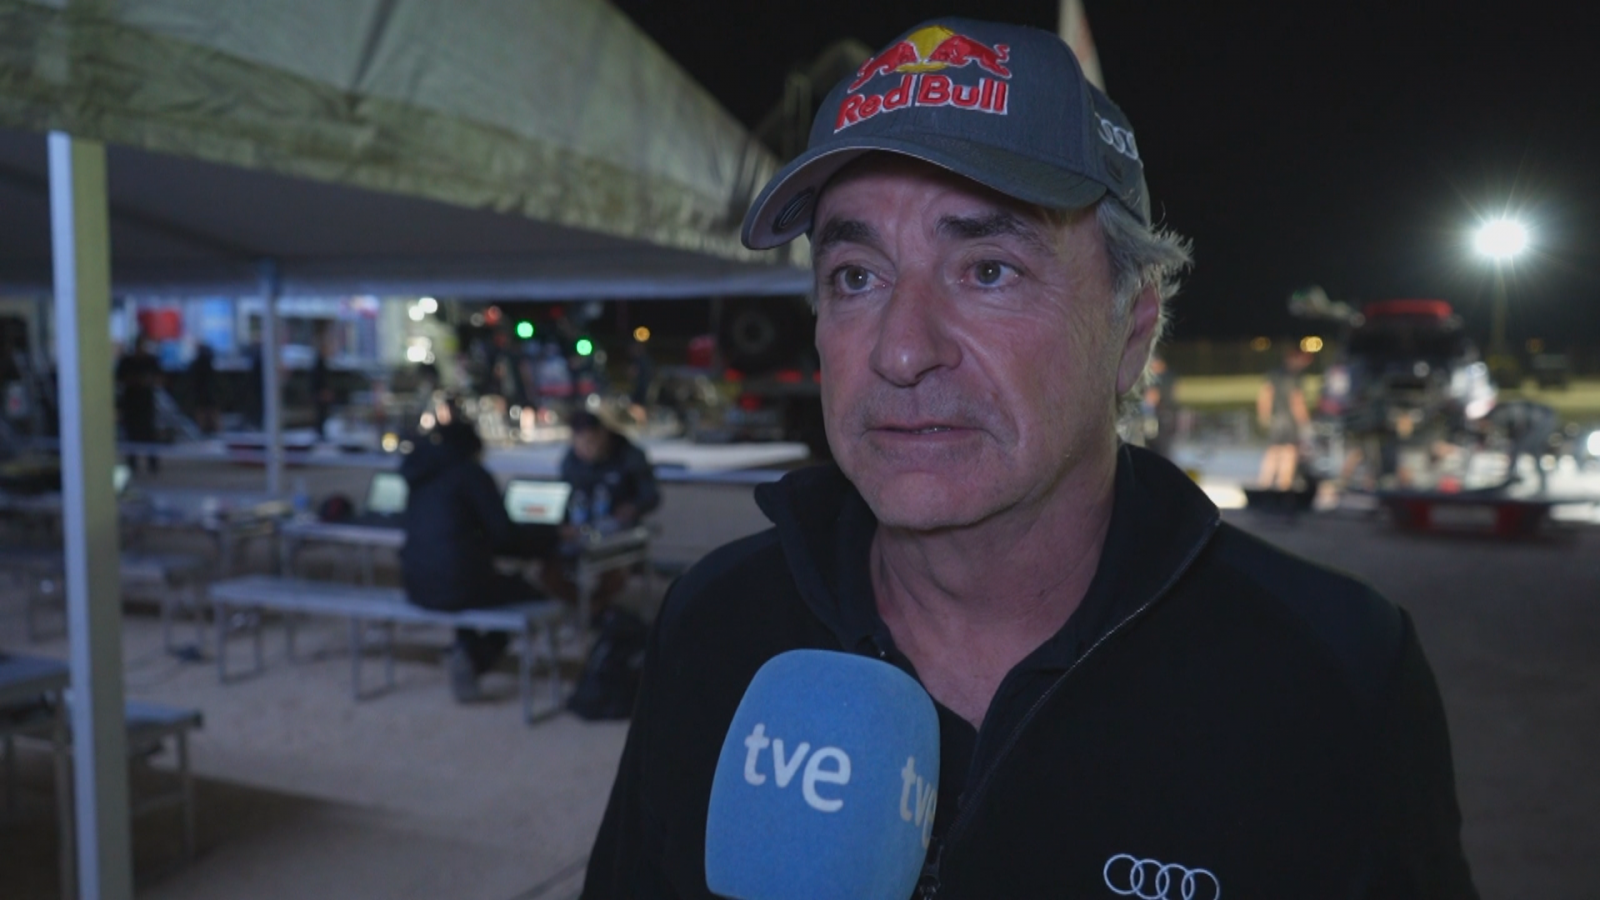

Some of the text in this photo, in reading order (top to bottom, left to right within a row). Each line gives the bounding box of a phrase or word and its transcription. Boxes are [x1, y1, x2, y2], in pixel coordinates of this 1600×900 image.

[834, 73, 1008, 133] Red Bull
[744, 723, 851, 812] tve
